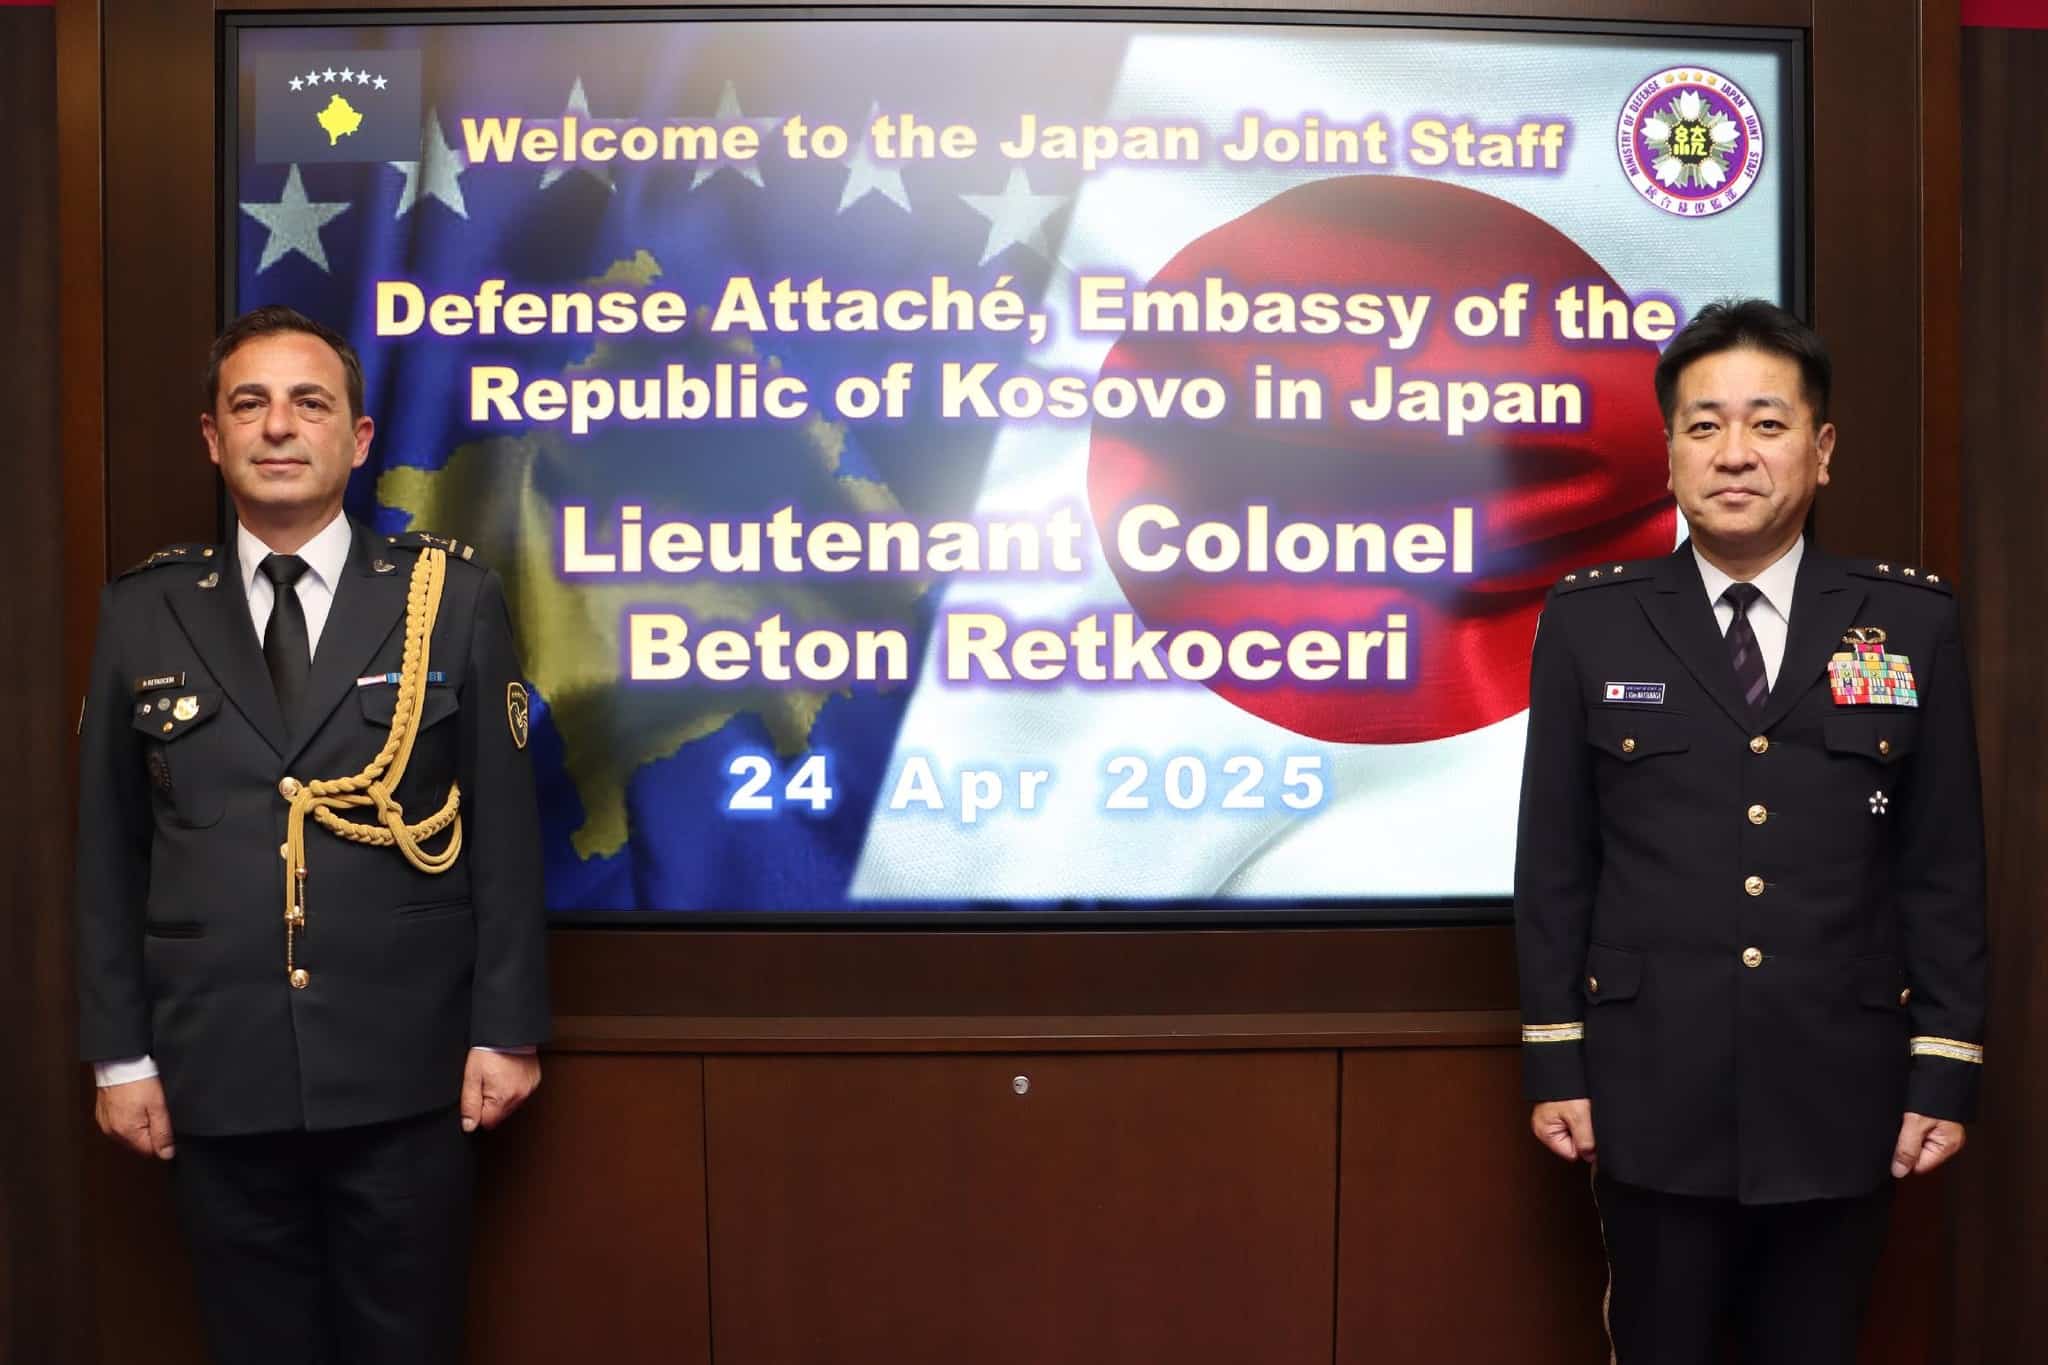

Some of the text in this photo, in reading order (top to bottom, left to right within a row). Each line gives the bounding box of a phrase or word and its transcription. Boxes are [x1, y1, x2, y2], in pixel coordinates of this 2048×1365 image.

[461, 114, 1565, 170] Welcome to the Japan Joint Staff
[1621, 80, 1662, 177] MINISTRY OF DEFENSE
[1721, 83, 1760, 179] JAPAN JOINT STAFF
[377, 274, 1676, 349] Defense Attaché, Embassy of the
[470, 363, 1583, 436] Republic of Kosovo in Japan
[564, 504, 1473, 574] Lieutenant Colonel
[630, 614, 1408, 681] Beton Retkoceri
[728, 755, 1324, 823] 24 Apr 2025
